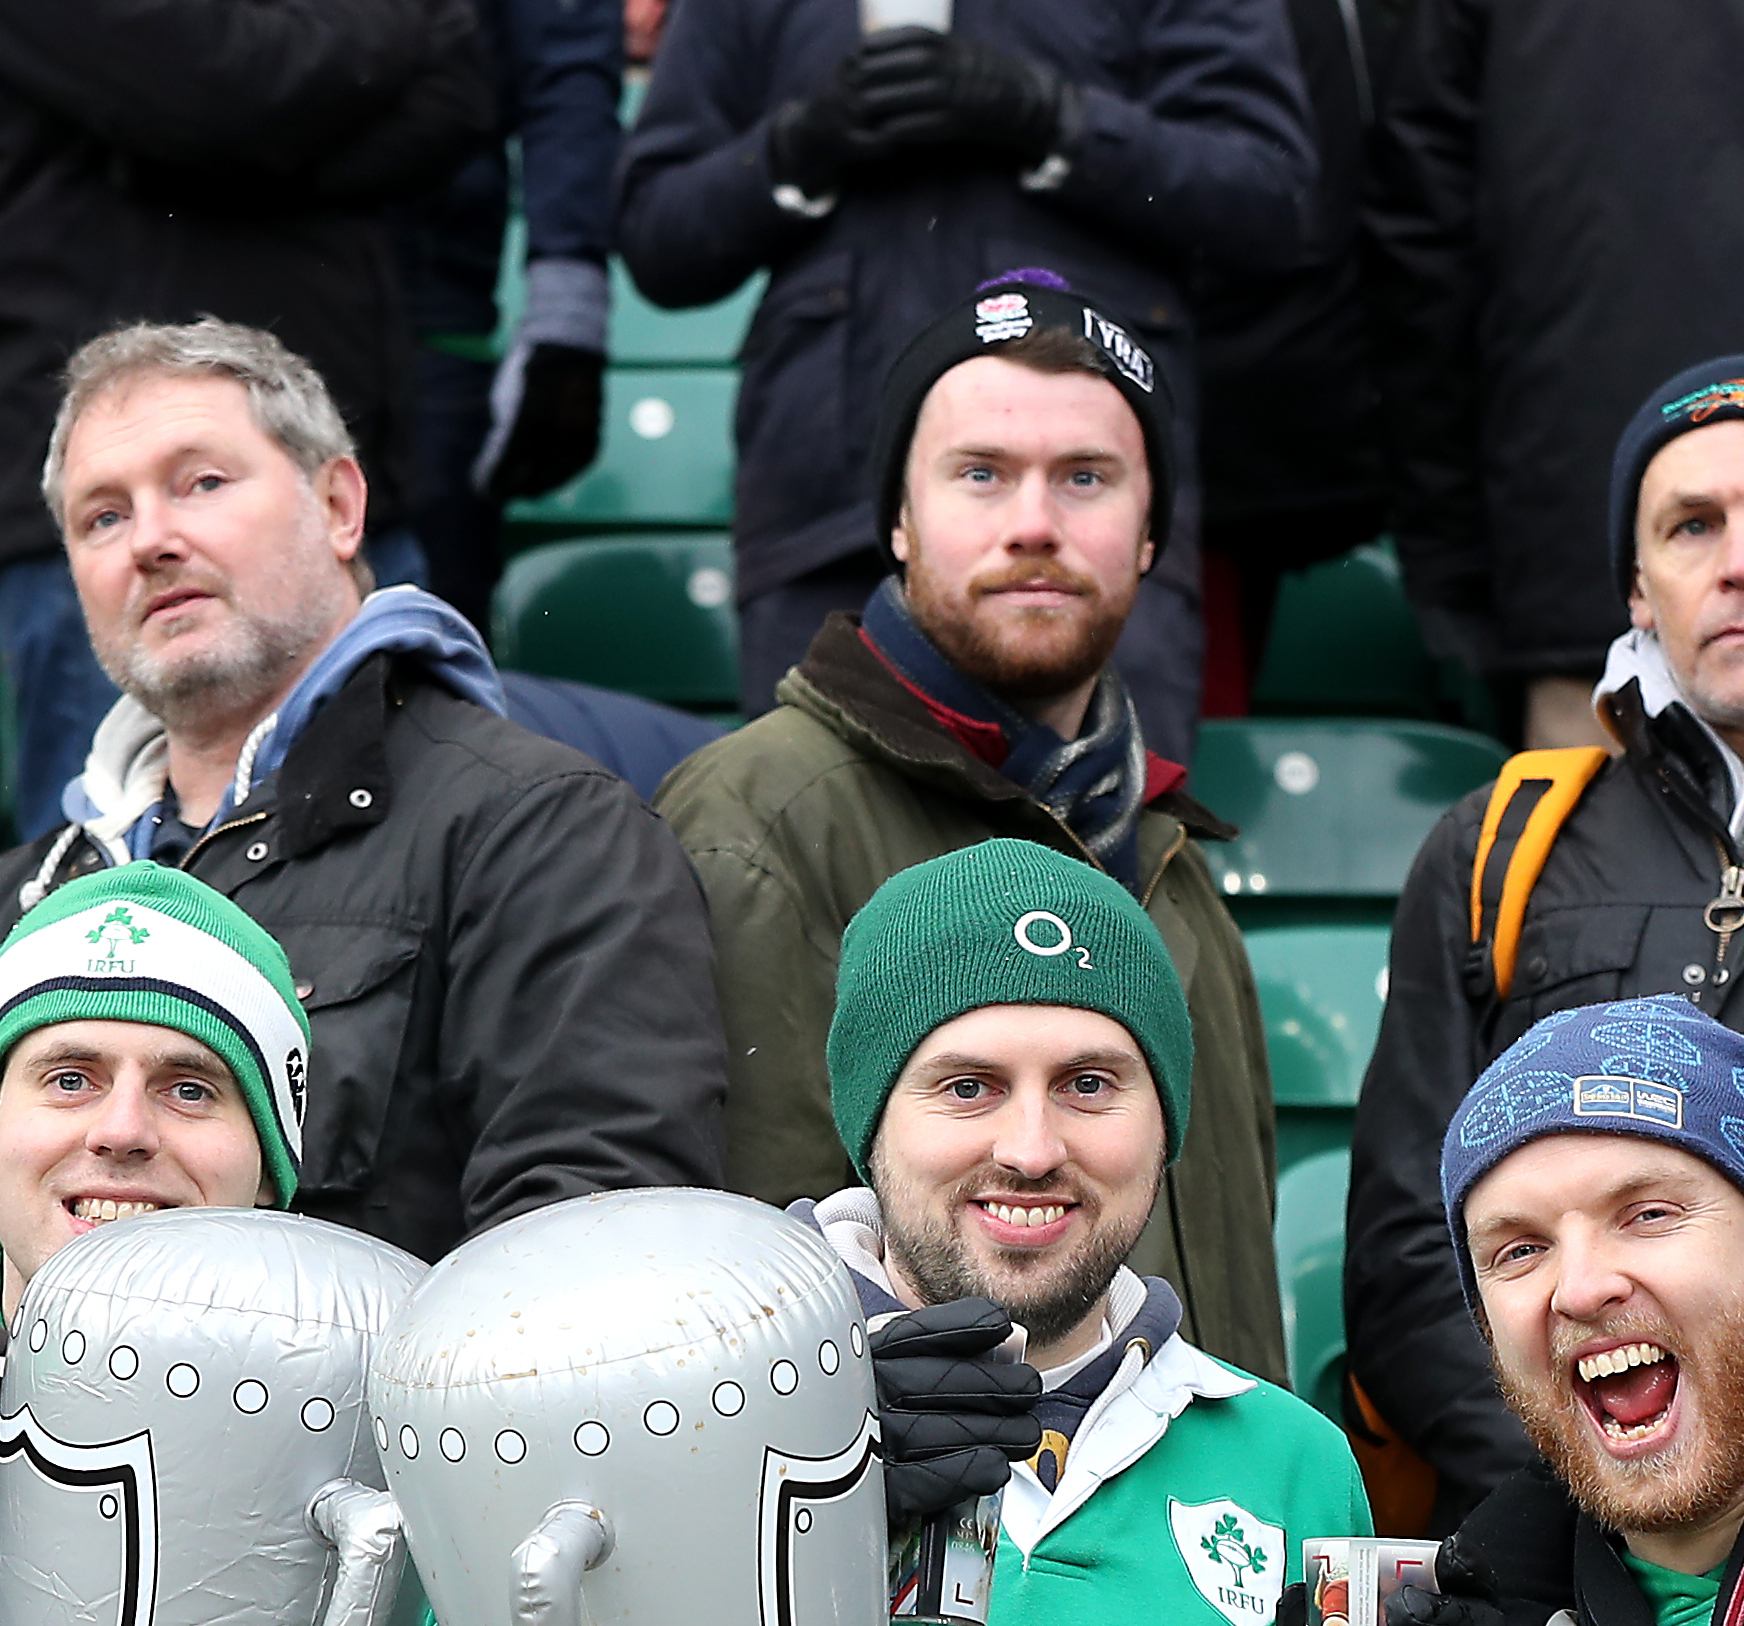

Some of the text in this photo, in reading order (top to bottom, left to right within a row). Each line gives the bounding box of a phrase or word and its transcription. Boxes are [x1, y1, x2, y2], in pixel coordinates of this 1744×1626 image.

[1014, 910, 1093, 970] O2
[87, 959, 135, 974] IRFU
[1217, 1586, 1264, 1615] IRFU
